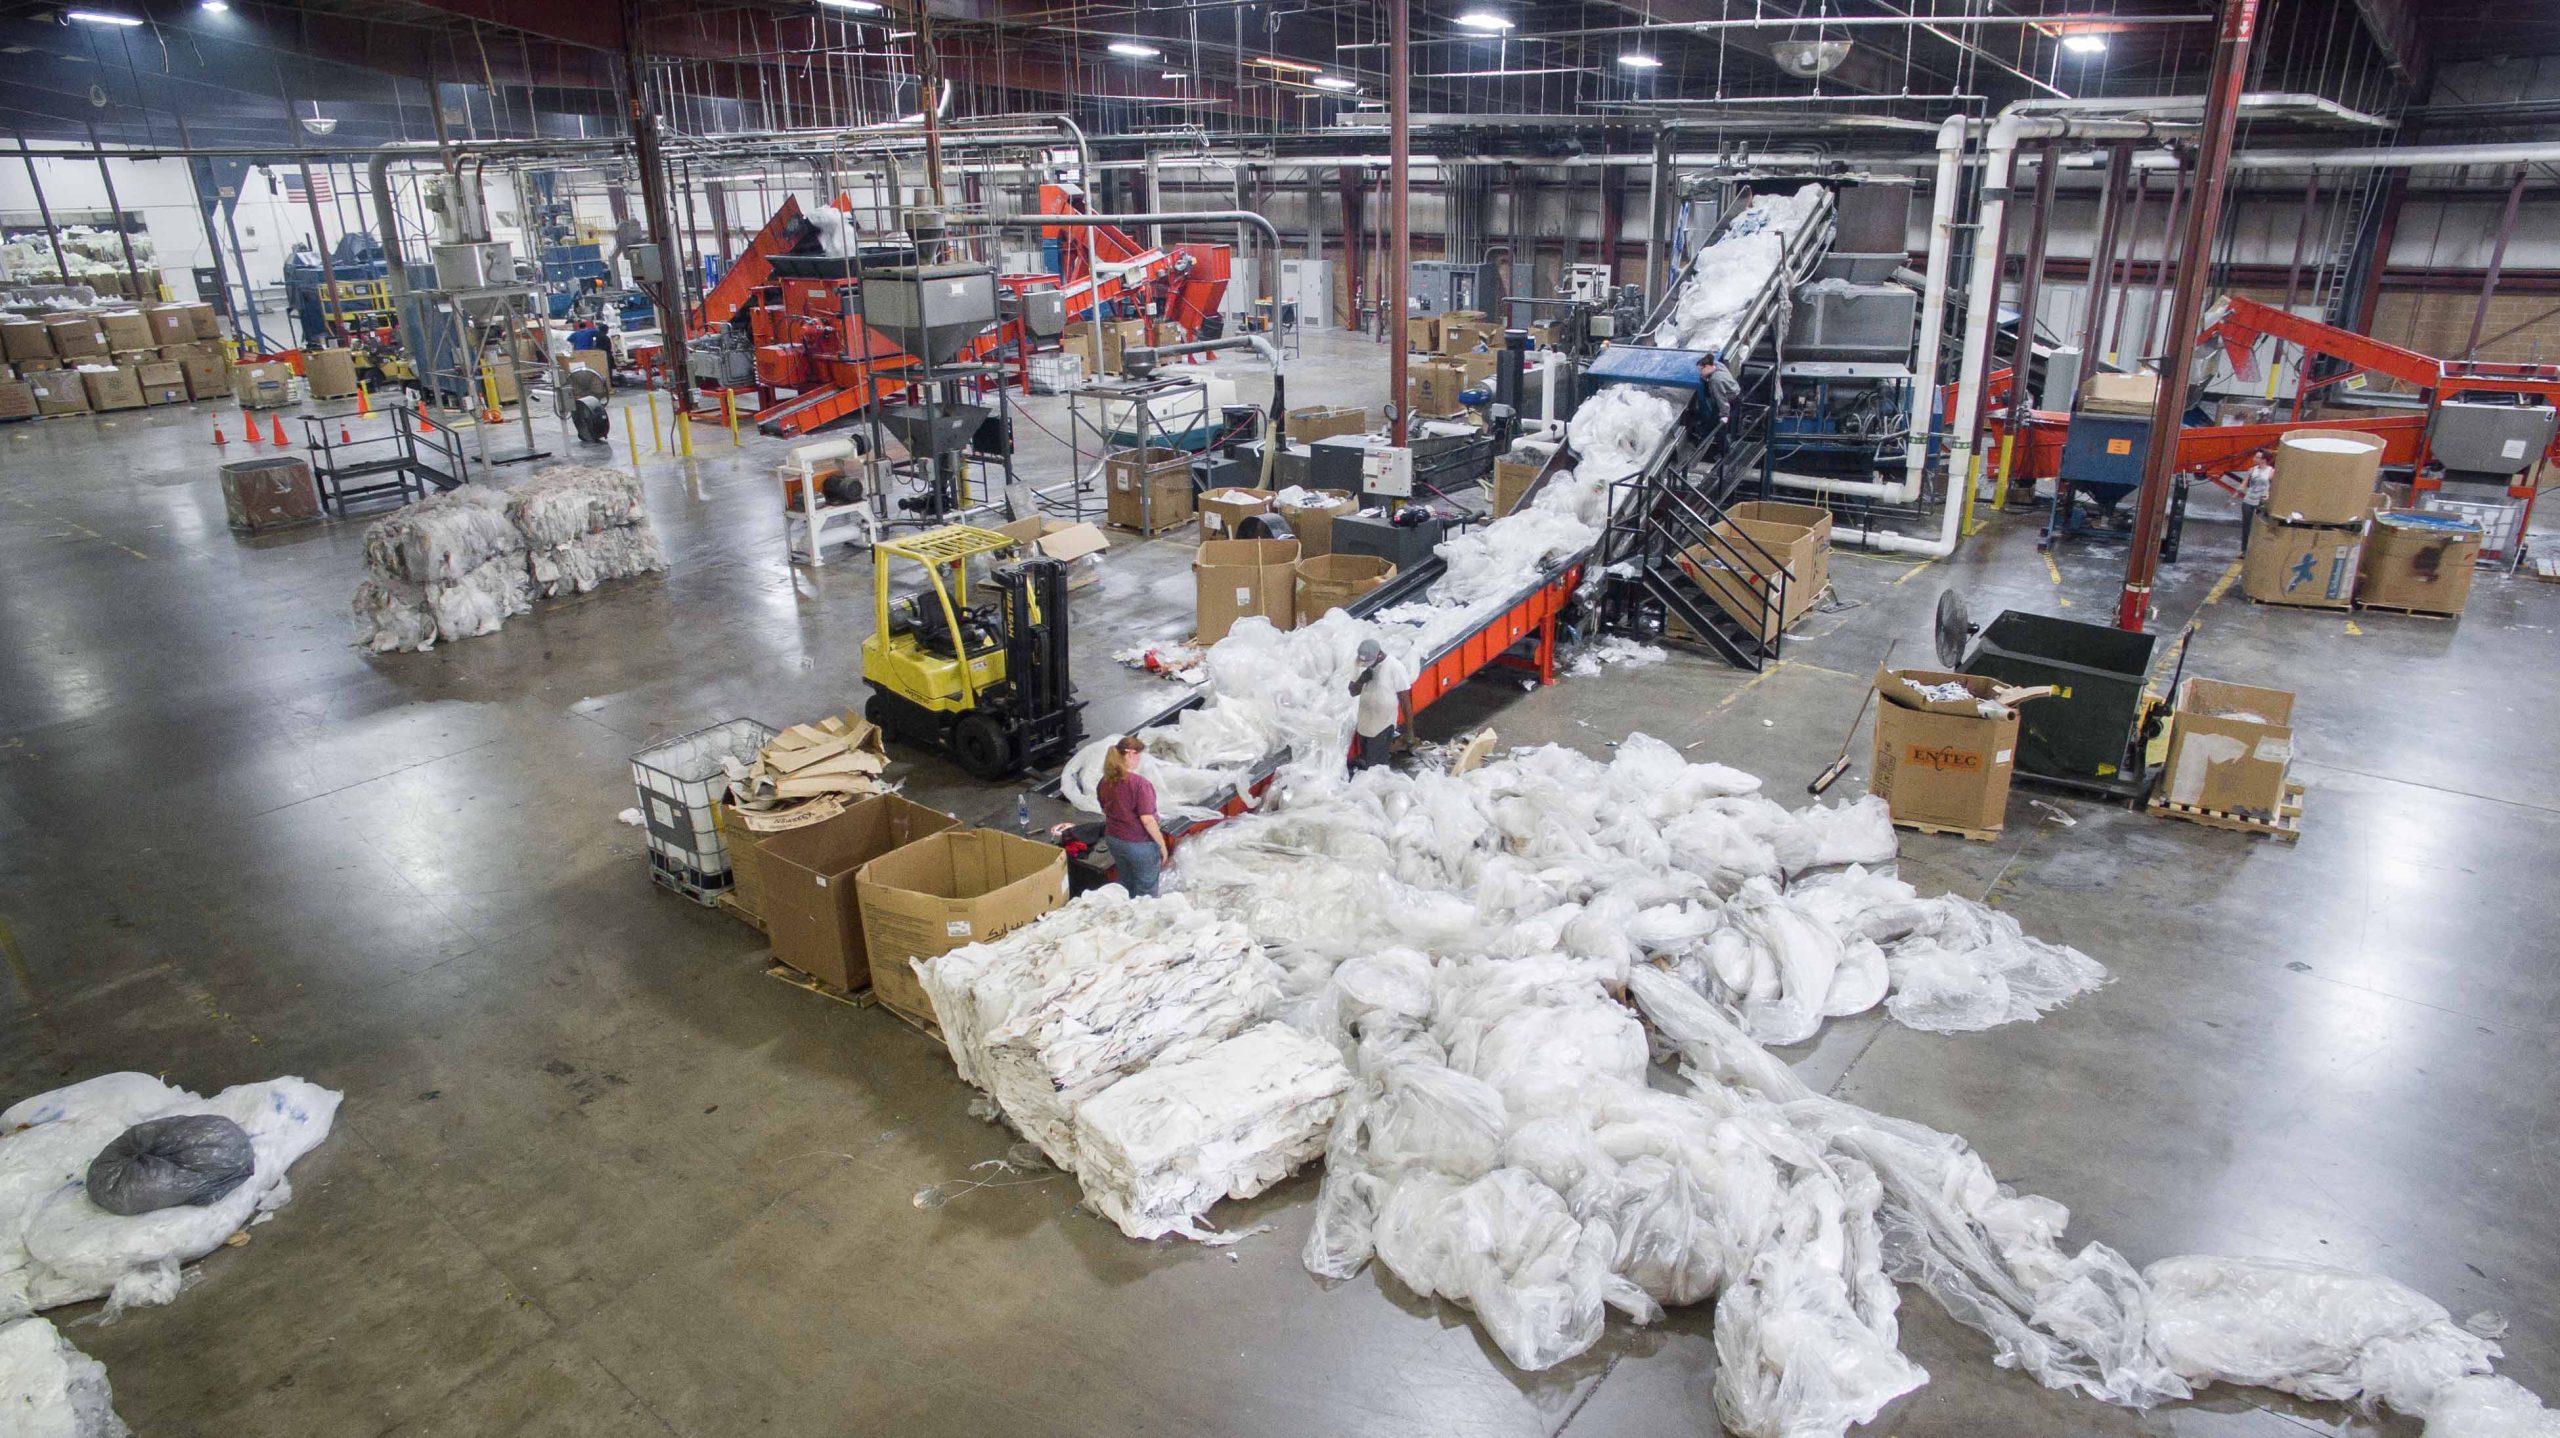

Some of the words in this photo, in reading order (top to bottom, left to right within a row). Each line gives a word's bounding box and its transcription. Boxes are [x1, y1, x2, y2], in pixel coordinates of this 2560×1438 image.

[2545, 412, 2554, 421] 4
[1006, 589, 1015, 638] HYSTER
[1914, 746, 1977, 771] ENTEC
